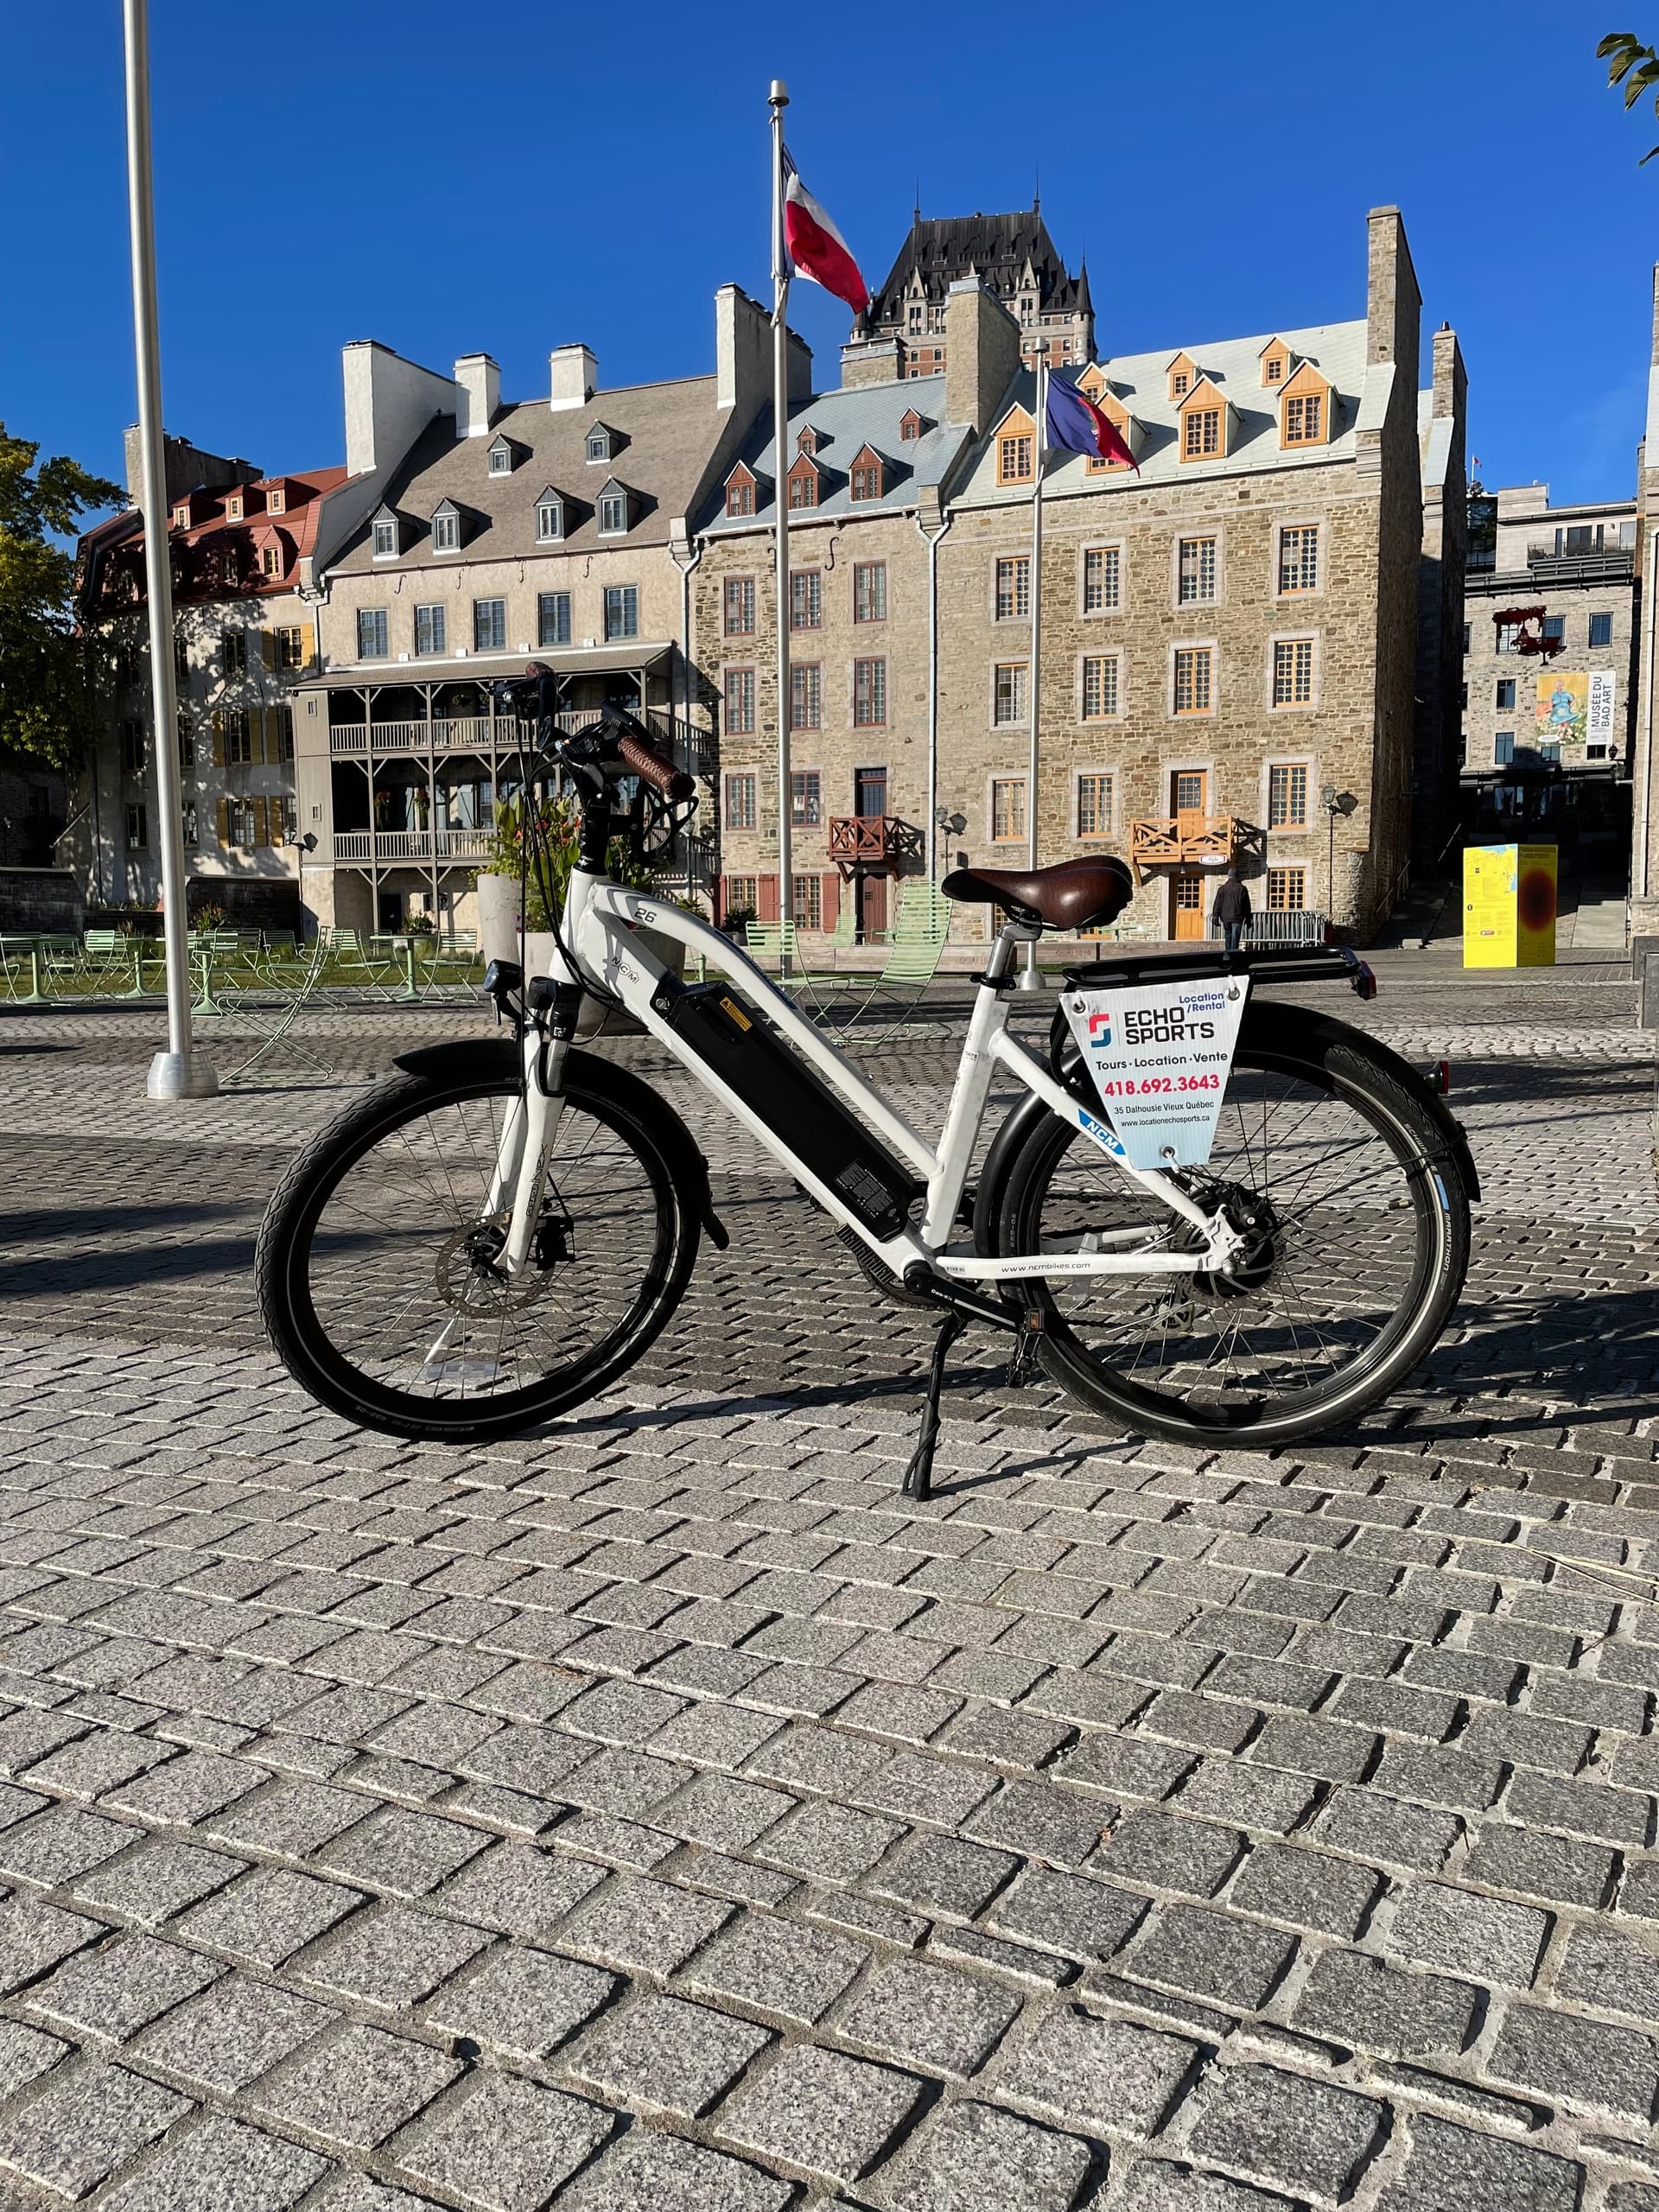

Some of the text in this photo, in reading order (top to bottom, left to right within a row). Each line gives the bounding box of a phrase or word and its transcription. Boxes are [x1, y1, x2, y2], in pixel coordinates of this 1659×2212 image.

[1592, 677, 1603, 690] DU
[1590, 693, 1601, 728] MUSÉE
[1601, 684, 1611, 727] BAD ART
[634, 907, 658, 923] 26
[612, 957, 639, 984] NCM
[1179, 993, 1224, 1004] Location
[1186, 1001, 1225, 1014] /Rental
[1124, 1007, 1185, 1027] ECHO
[1125, 1022, 1215, 1046] SPORTS
[1096, 1051, 1229, 1071] Tours Location Vente
[1103, 1074, 1221, 1096] 418.692.3643
[1114, 1100, 1215, 1115] 35 Dalhousie Vieux Québec
[1121, 1114, 1211, 1128] www.locationechosports.ca
[1086, 1121, 1119, 1150] NCM
[1444, 1212, 1452, 1271] MARATHON
[1001, 1262, 1091, 1273] www.ncmbikes.com
